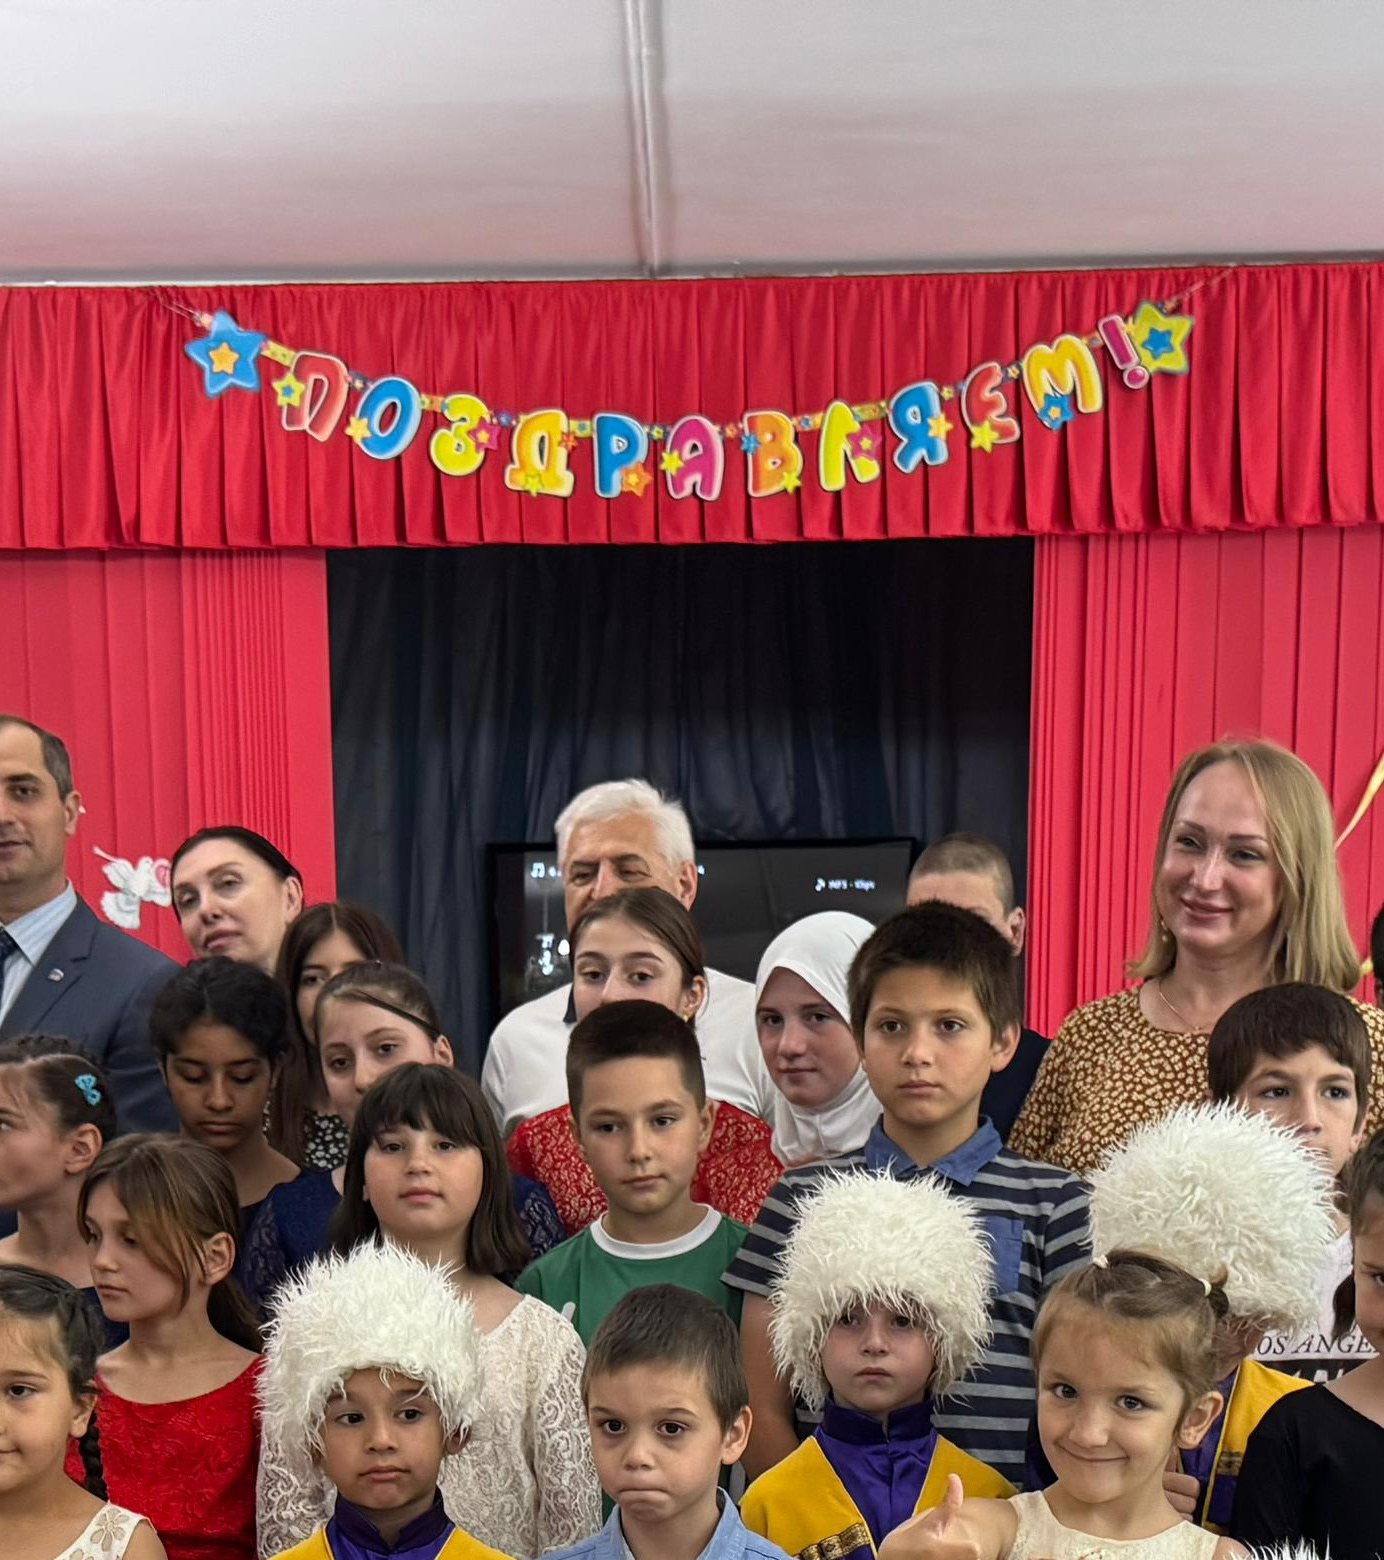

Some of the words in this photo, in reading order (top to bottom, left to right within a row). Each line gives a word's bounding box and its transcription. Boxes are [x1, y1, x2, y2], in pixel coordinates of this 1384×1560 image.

[279, 314, 1151, 500] ПОЗДРАВЛЯЕМ!
[1257, 1335, 1288, 1356] OS
[1291, 1334, 1378, 1355] ANGE
